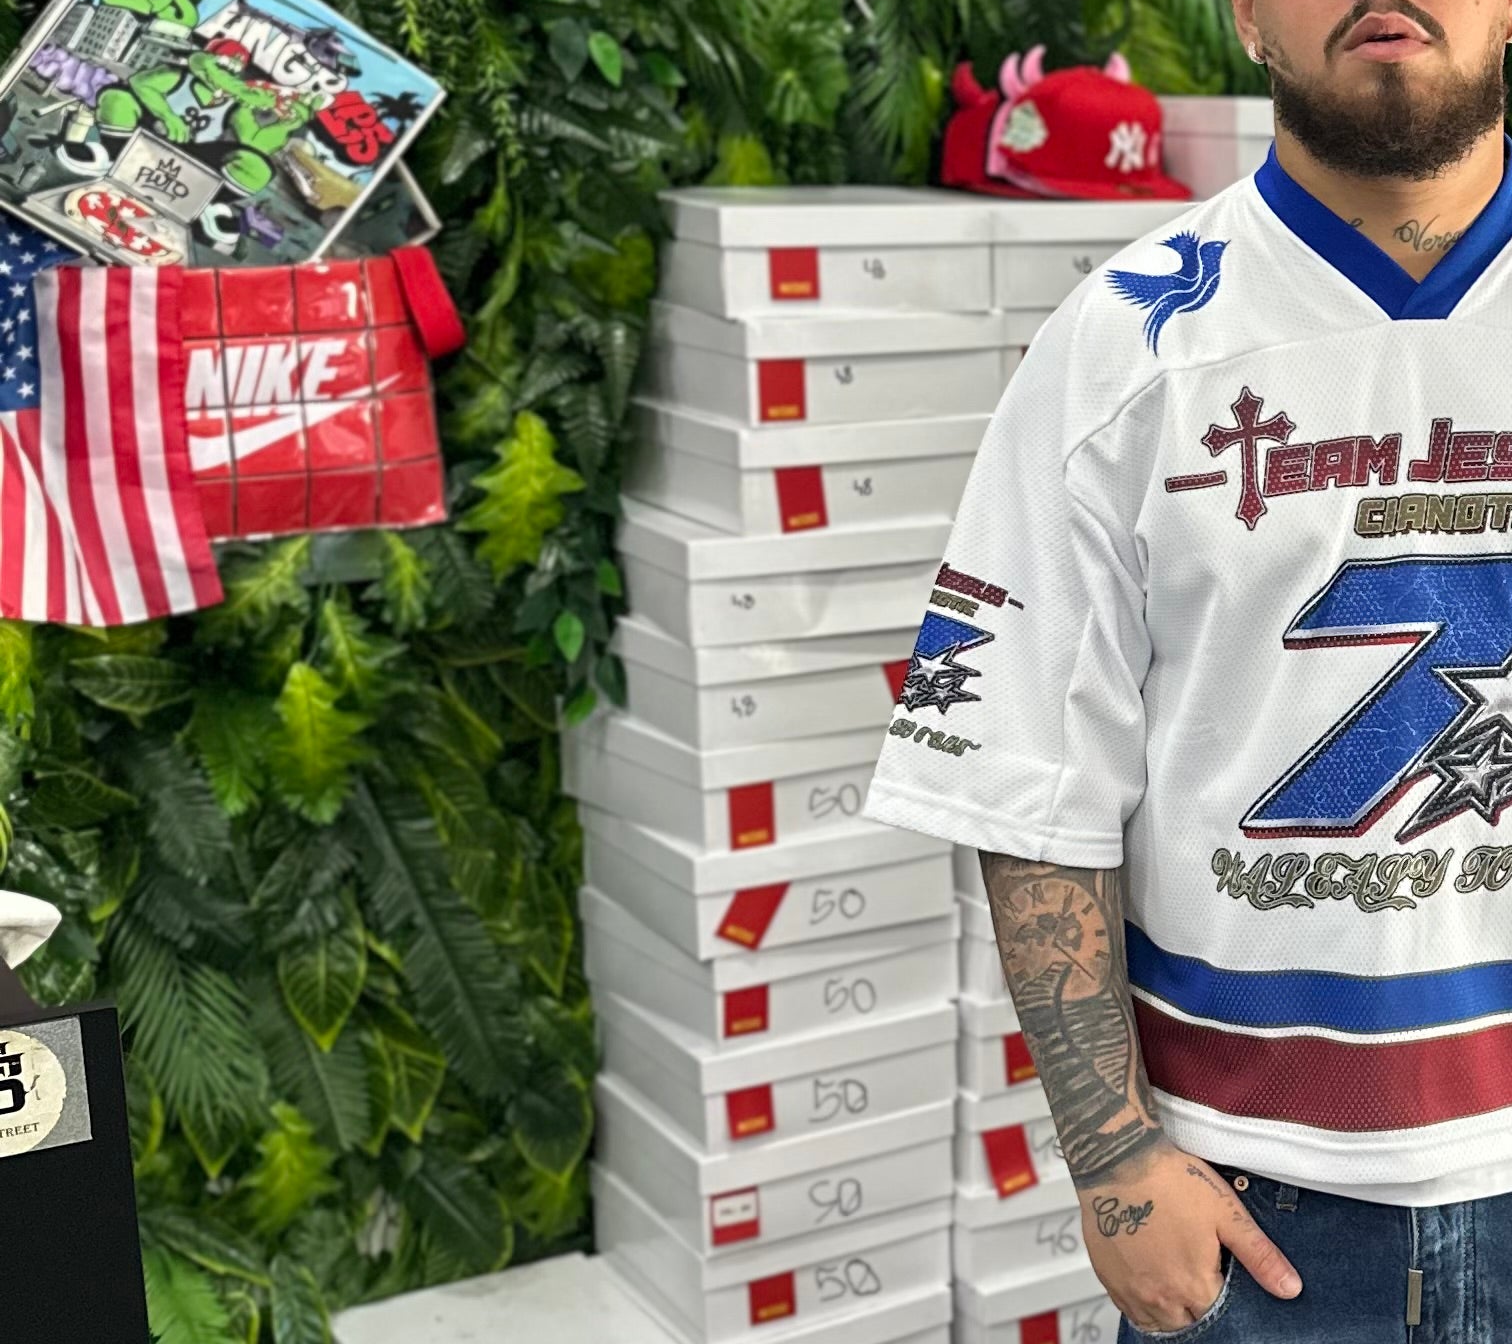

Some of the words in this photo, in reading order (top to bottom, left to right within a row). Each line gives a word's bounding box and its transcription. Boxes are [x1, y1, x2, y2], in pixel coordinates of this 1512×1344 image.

[184, 338, 348, 420] NIKE
[808, 782, 862, 819] 50
[809, 887, 866, 926] 50
[823, 977, 877, 1014] 50
[807, 1077, 869, 1123] 50
[814, 1258, 882, 1302] 50
